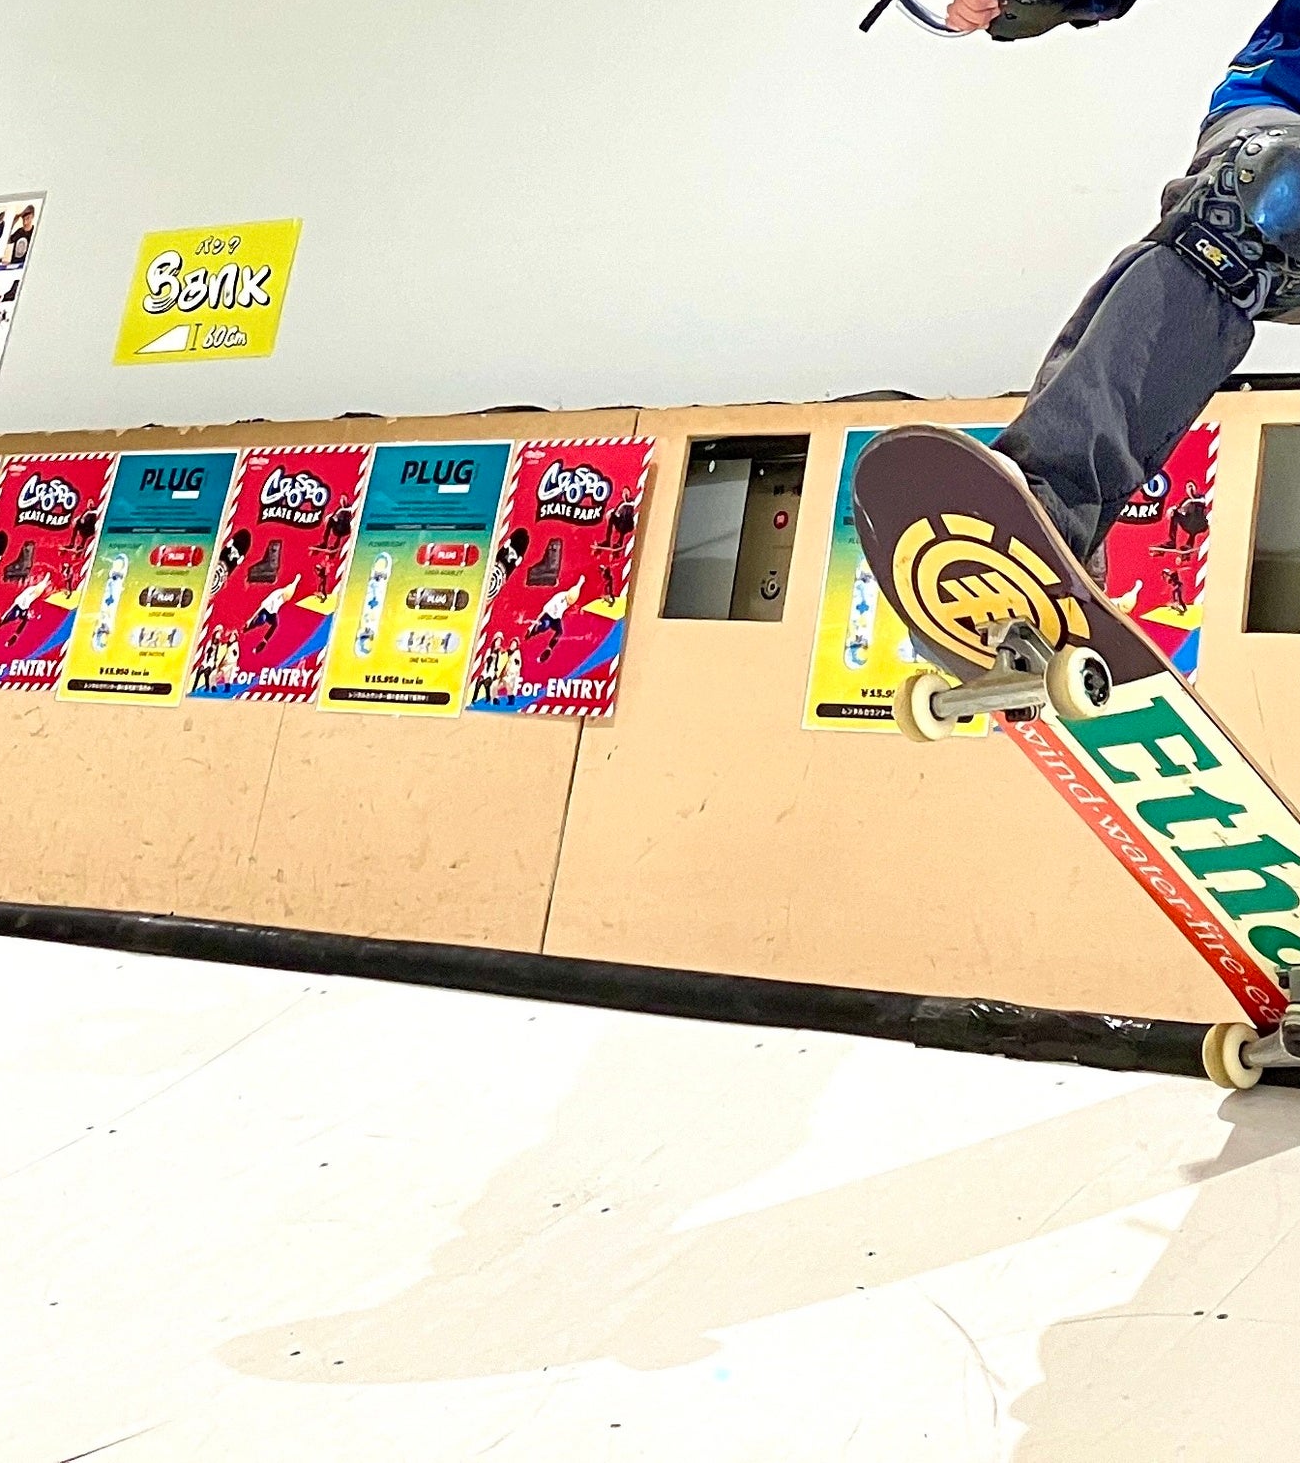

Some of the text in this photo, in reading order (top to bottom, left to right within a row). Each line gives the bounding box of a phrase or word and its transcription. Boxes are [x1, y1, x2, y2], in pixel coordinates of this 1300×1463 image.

[139, 467, 205, 490] PLUG
[400, 459, 475, 485] PLUG
[18, 509, 72, 526] SKATE PARK
[262, 508, 322, 523] SKATE PARK
[539, 504, 605, 520] SKATE PARK
[1120, 502, 1159, 518] PARK
[9, 659, 57, 677] ENTRY
[231, 667, 315, 688] For ENTRY
[513, 677, 609, 700] For ENTRY
